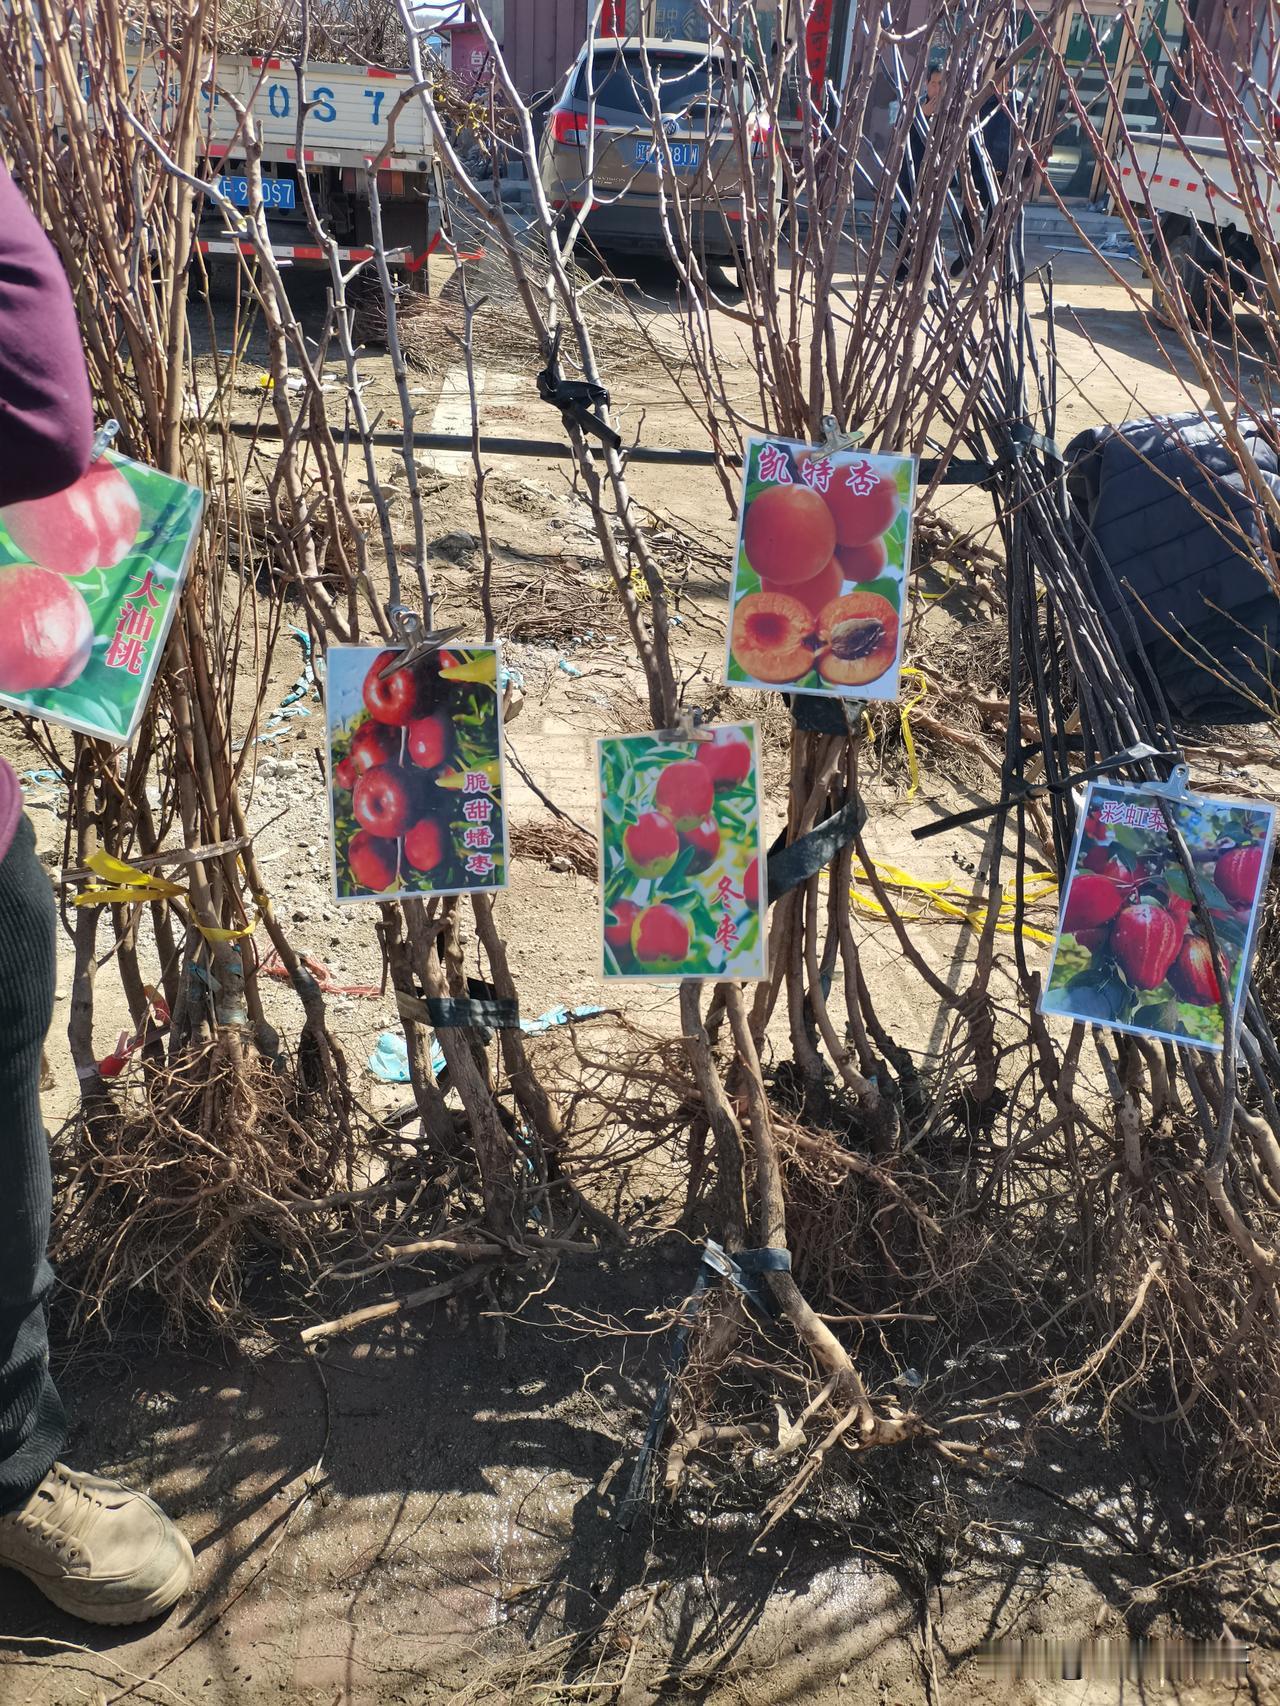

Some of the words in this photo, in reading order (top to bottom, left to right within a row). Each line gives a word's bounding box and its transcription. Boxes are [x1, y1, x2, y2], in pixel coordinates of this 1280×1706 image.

[758, 444, 880, 496] 凯特杏
[104, 569, 166, 675] 大油桃
[463, 772, 495, 875] 脆甜蟠枣
[710, 875, 746, 952] 冬枣
